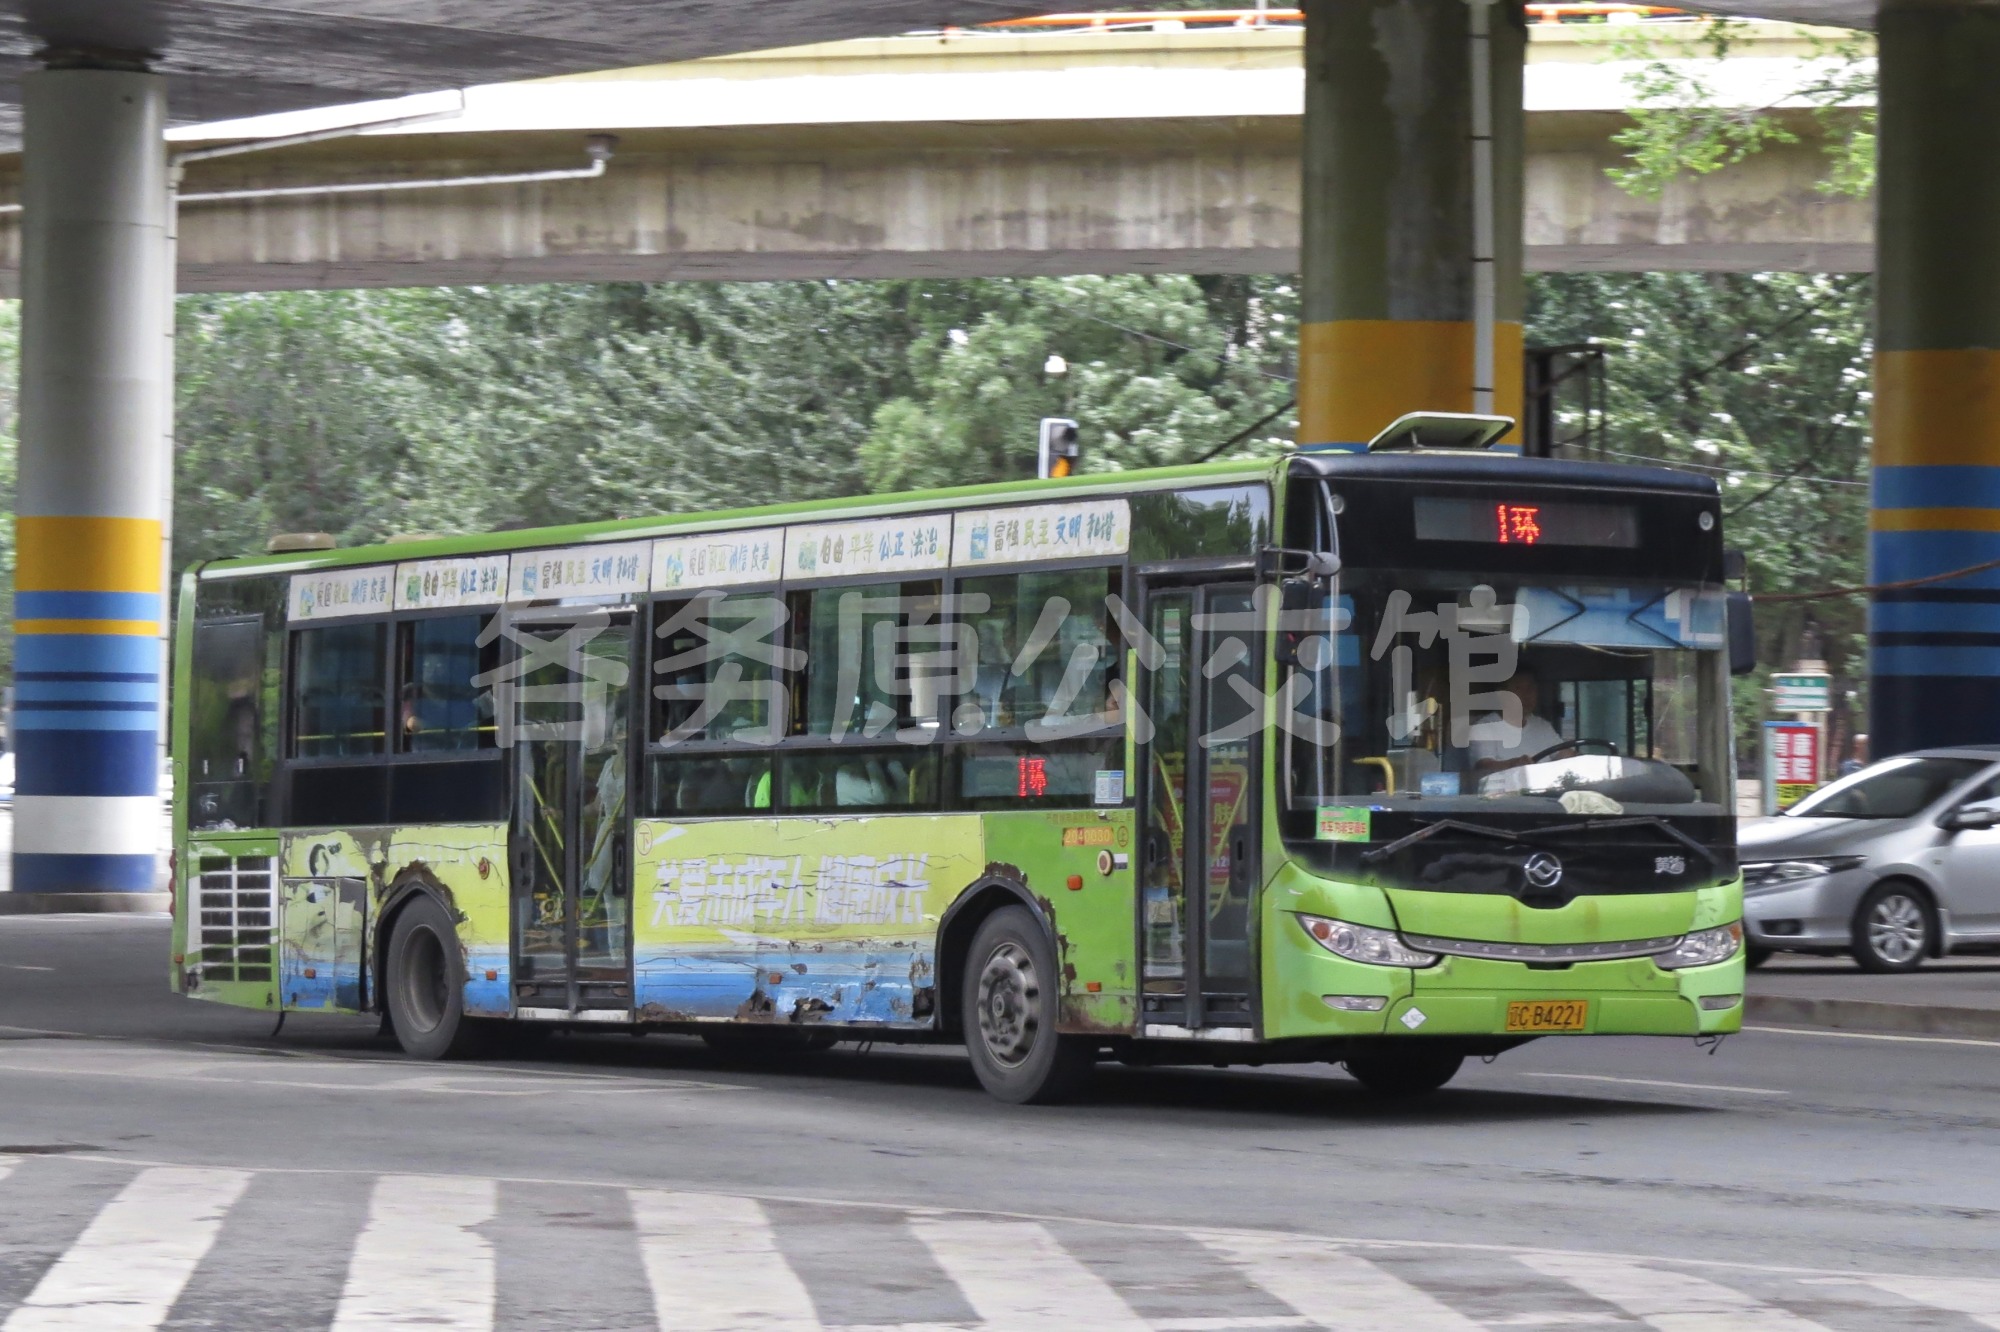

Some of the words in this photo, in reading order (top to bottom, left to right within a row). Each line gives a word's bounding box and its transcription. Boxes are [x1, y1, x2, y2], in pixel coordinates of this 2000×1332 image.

[820, 534, 844, 564] 自由
[847, 531, 874, 564] 平等
[878, 530, 904, 561] 公正
[910, 527, 938, 559] 法治
[1023, 518, 1049, 548] 民主
[1053, 513, 1082, 546] 文明
